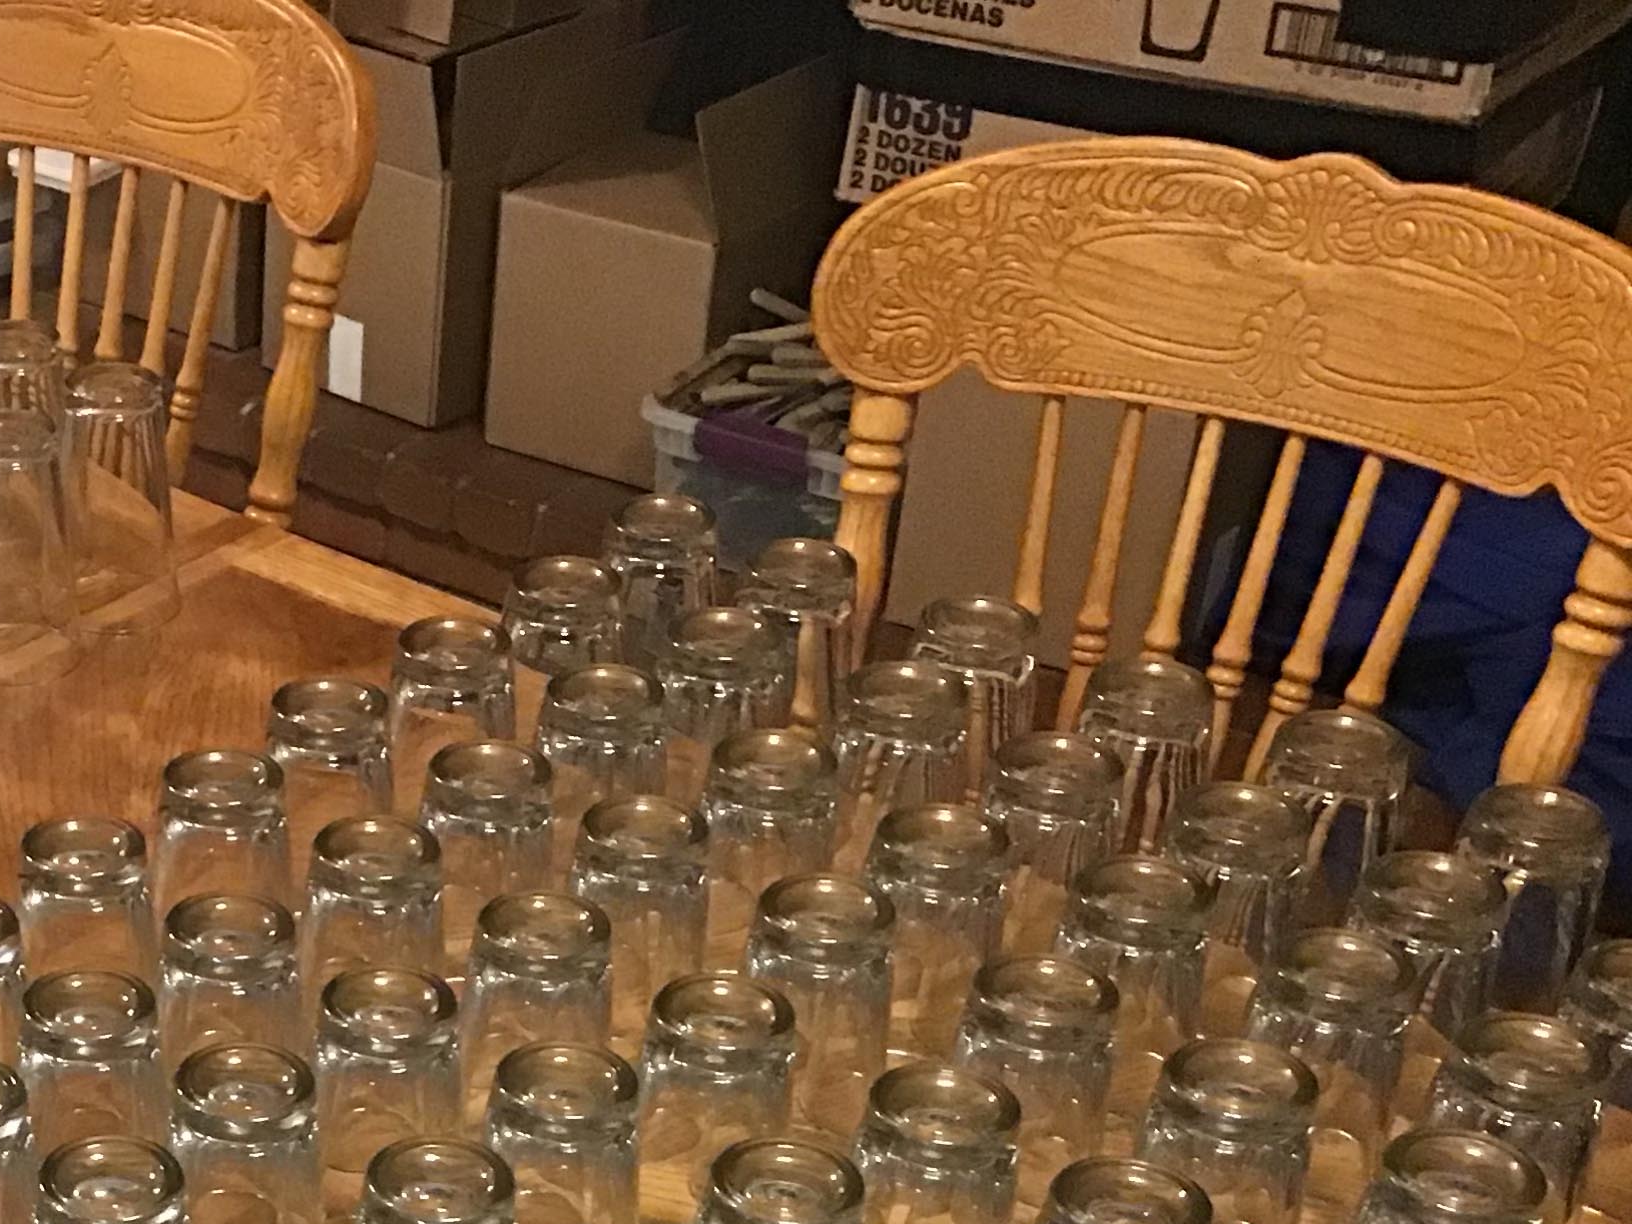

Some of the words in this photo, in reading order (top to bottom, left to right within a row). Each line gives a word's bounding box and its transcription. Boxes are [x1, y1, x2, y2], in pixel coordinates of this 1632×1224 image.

[857, 126, 870, 145] 2
[876, 129, 962, 162] DOZEN
[854, 148, 867, 167] 2
[874, 152, 944, 177] DOU
[850, 170, 864, 189] 2
